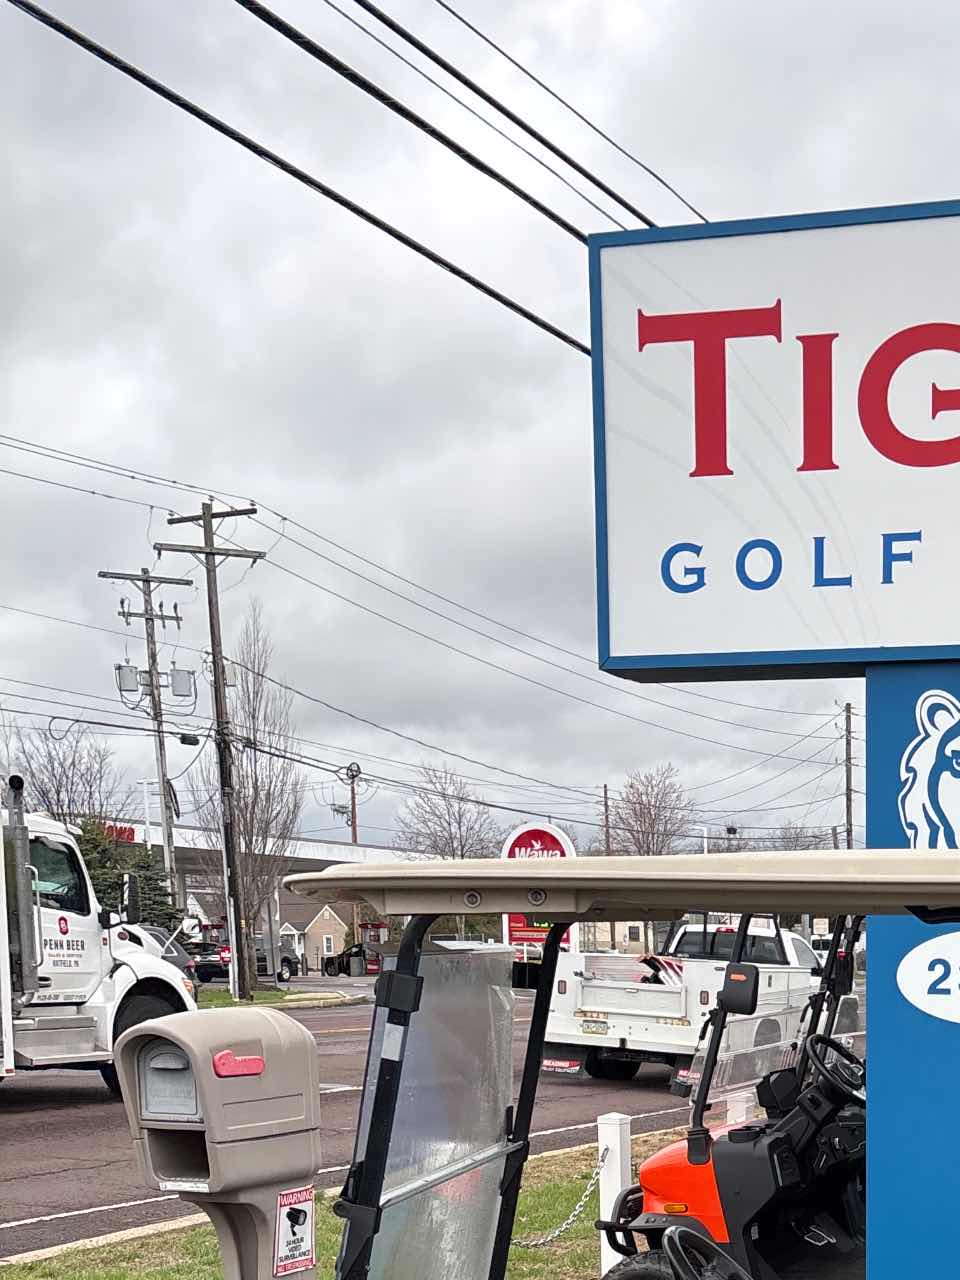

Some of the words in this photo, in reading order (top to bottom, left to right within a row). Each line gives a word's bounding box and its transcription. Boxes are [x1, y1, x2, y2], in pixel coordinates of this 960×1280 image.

[661, 530, 922, 594] GOLF
[43, 938, 64, 950] PENN
[66, 939, 85, 951] BEER
[280, 1188, 313, 1205] WARNING
[291, 1237, 304, 1245] HOUR
